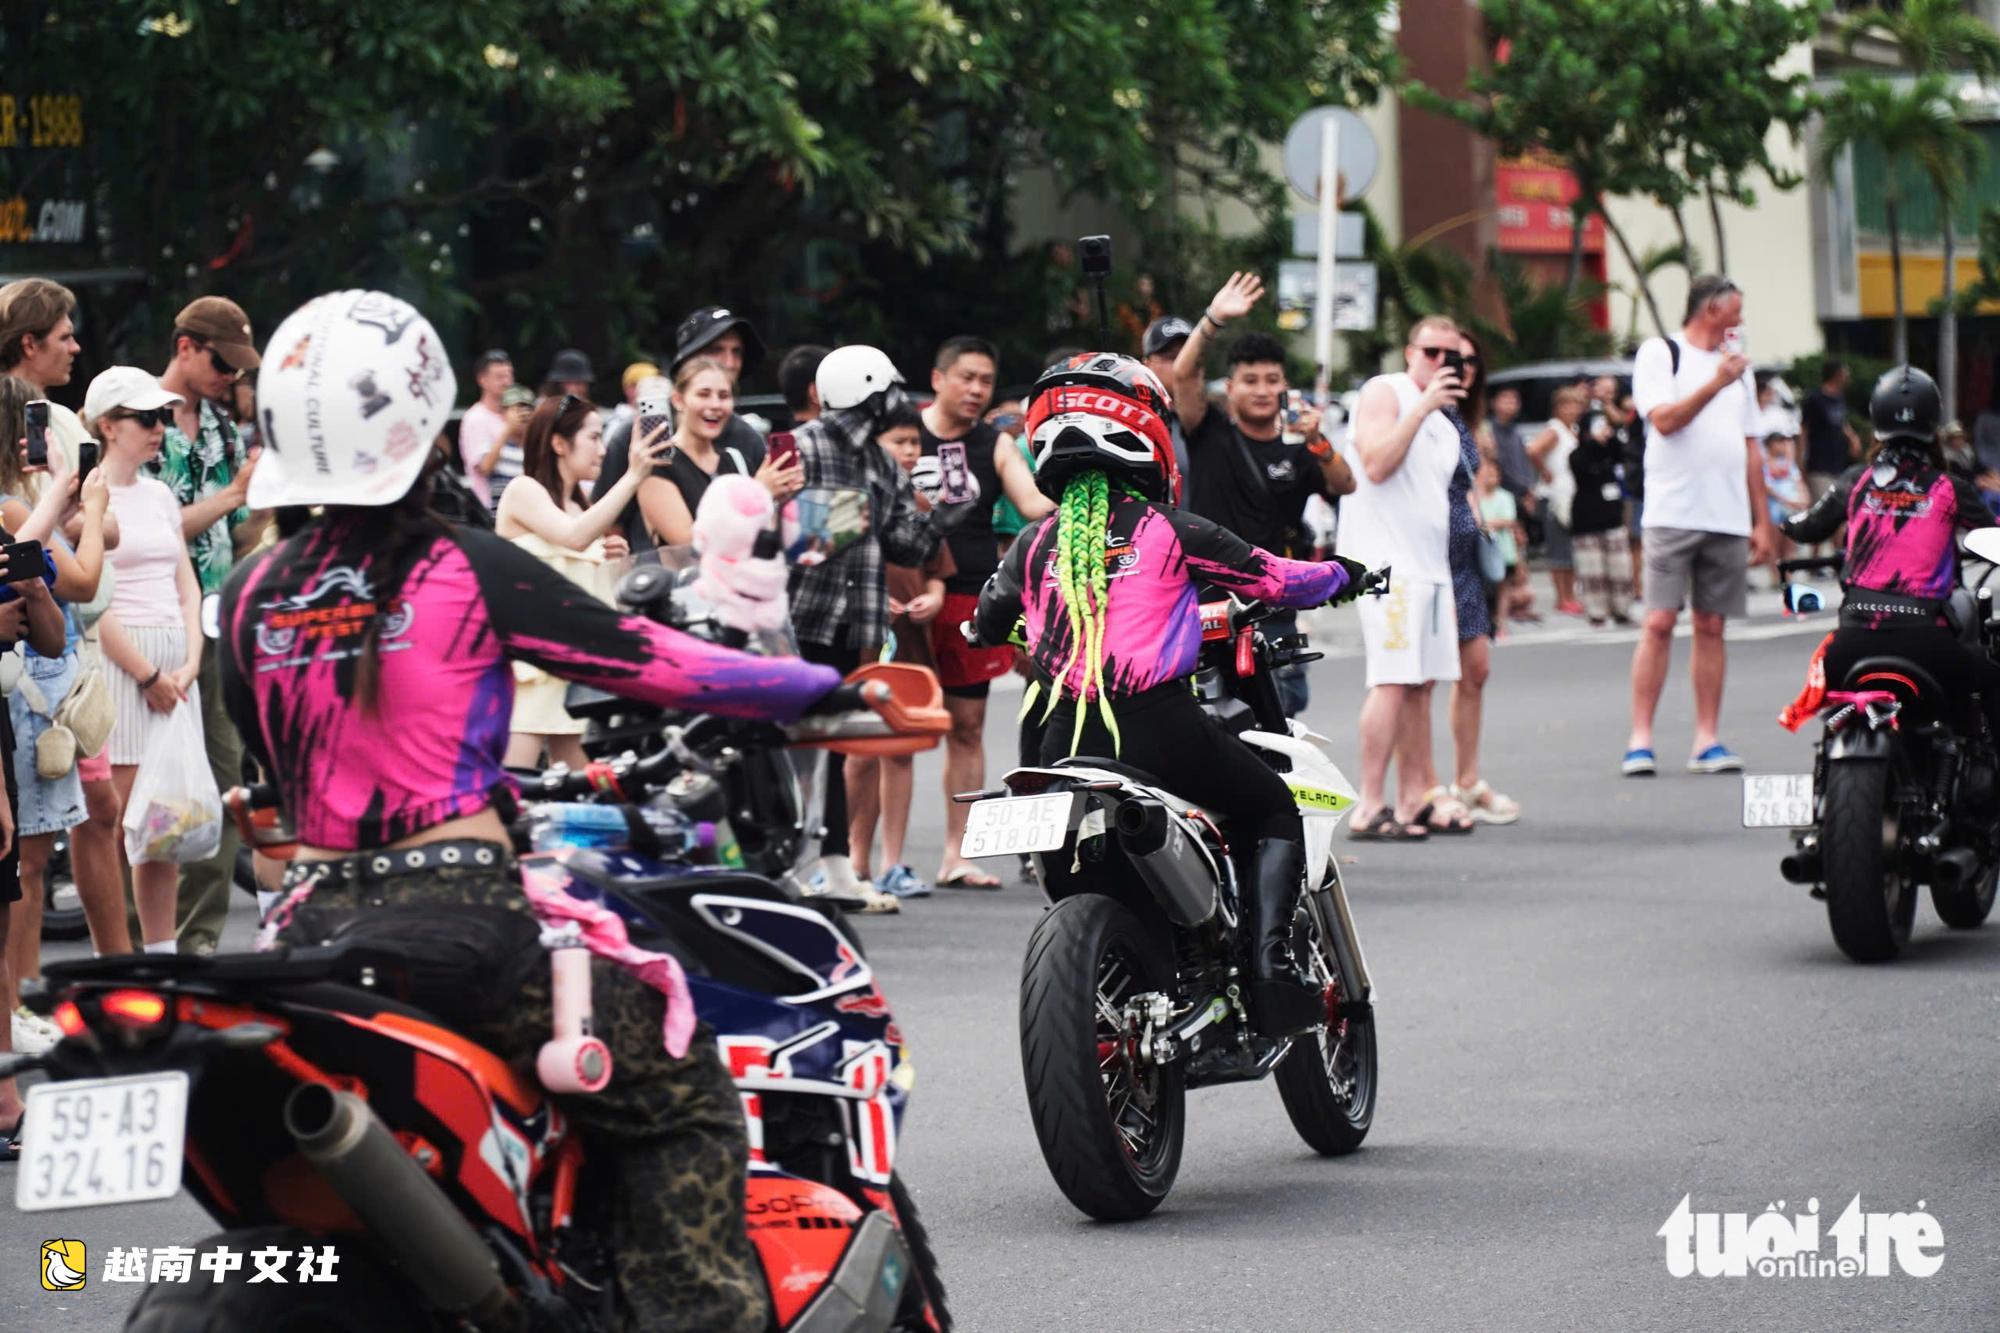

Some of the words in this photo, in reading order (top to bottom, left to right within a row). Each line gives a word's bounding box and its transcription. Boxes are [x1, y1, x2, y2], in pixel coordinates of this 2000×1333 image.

[1056, 392, 1154, 426] SCOTT
[985, 799, 1057, 826] 50-AE
[973, 824, 1056, 852] 518.01
[52, 1088, 159, 1143] 59-A3
[34, 1142, 164, 1199] 324.16
